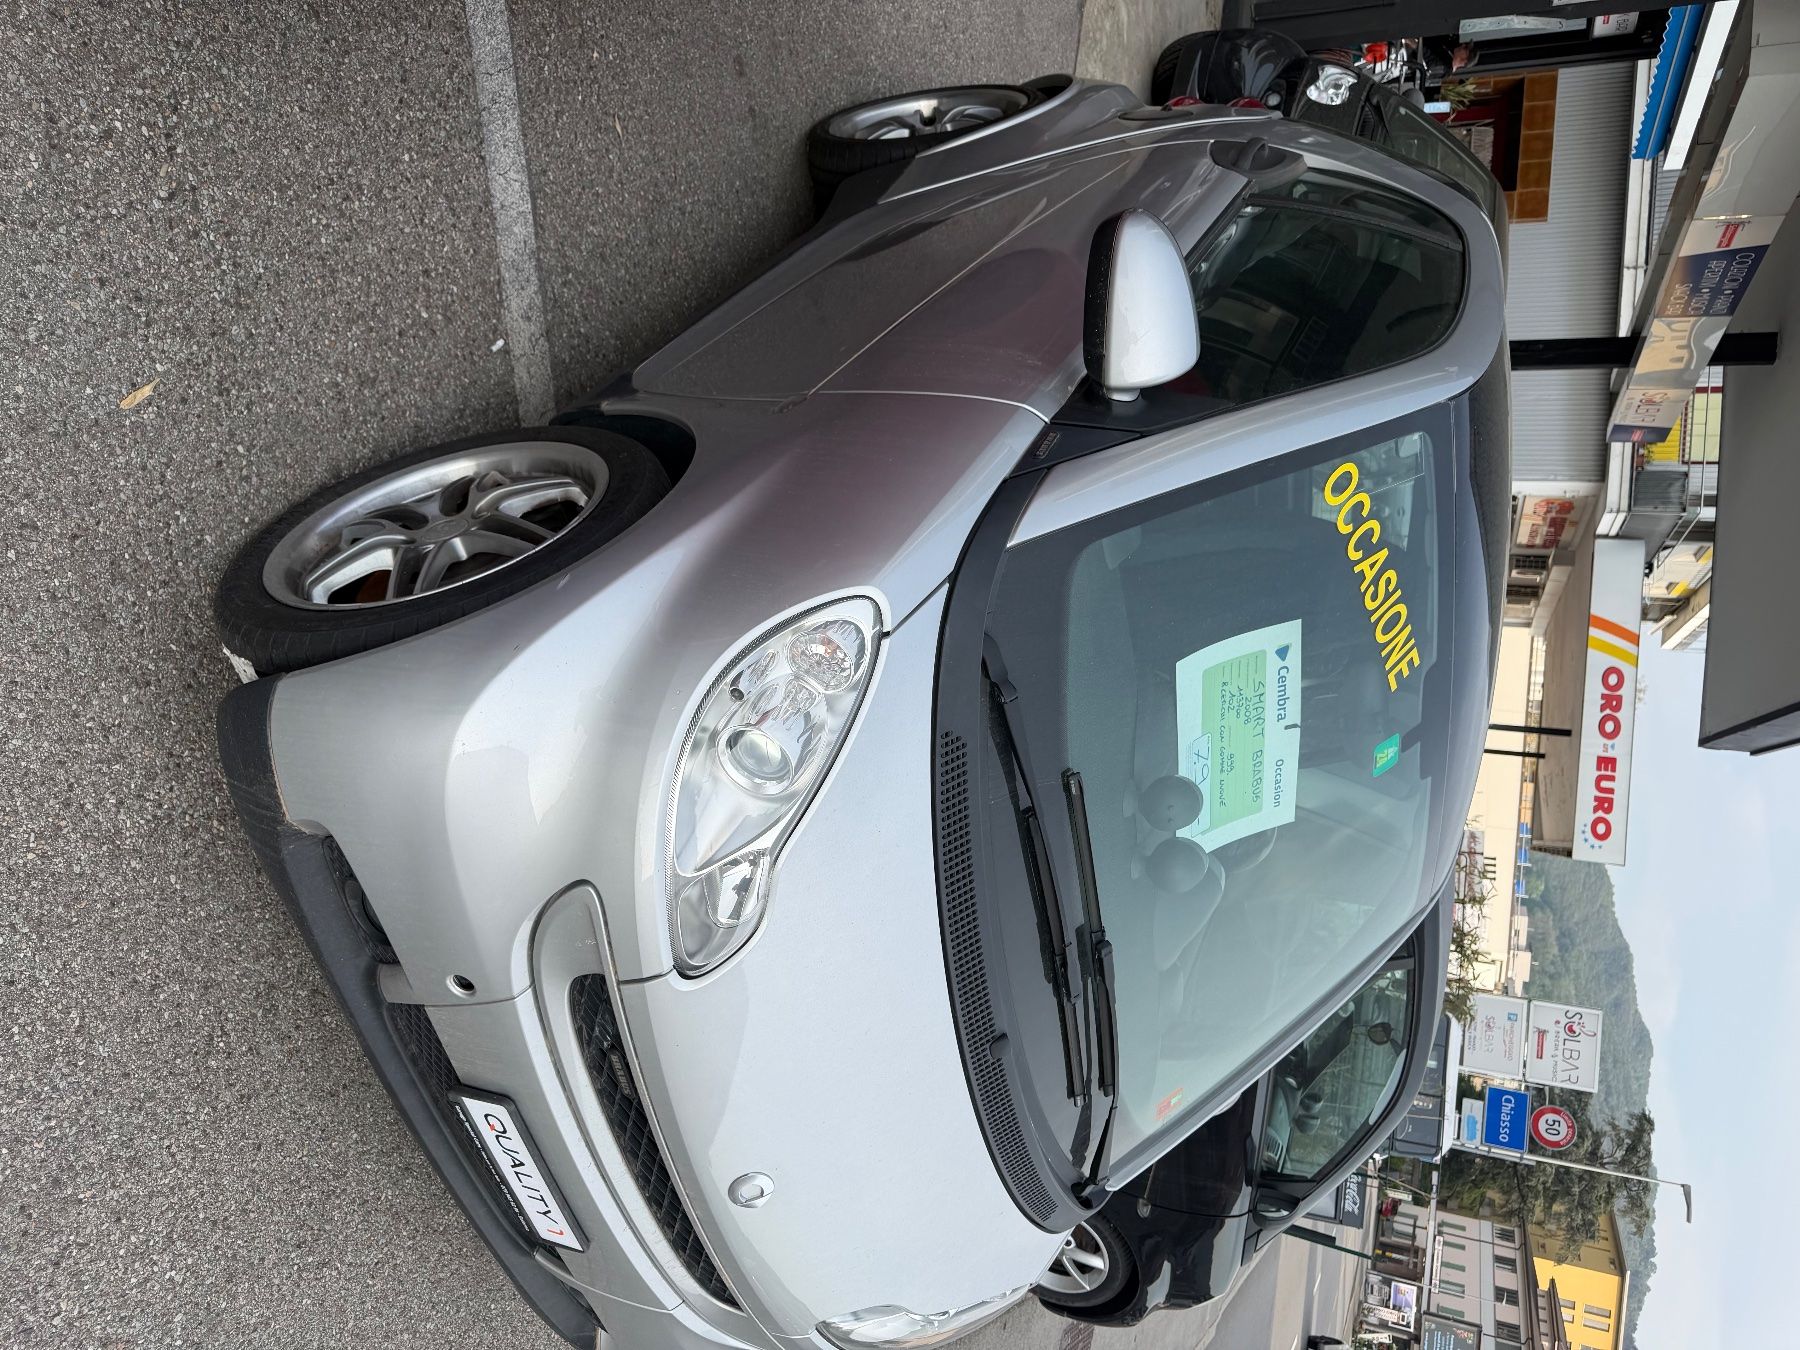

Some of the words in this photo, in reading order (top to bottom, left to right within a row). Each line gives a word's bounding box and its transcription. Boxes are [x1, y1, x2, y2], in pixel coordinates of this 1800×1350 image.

[1324, 462, 1421, 693] OCCASIONE
[1227, 691, 1236, 713] 102
[1244, 696, 1252, 725] 2008
[1251, 679, 1265, 738] SMART
[1276, 665, 1290, 723] Cembra
[1598, 666, 1625, 740] ORO
[1251, 749, 1263, 804] BRABUS
[1273, 759, 1285, 808] Occasion
[1590, 755, 1617, 842] EURO
[610, 1055, 632, 1095] BRABUS
[1560, 1010, 1584, 1085] SOLBAR
[1498, 1095, 1515, 1142] Chiasso
[1545, 1119, 1561, 1136] 50
